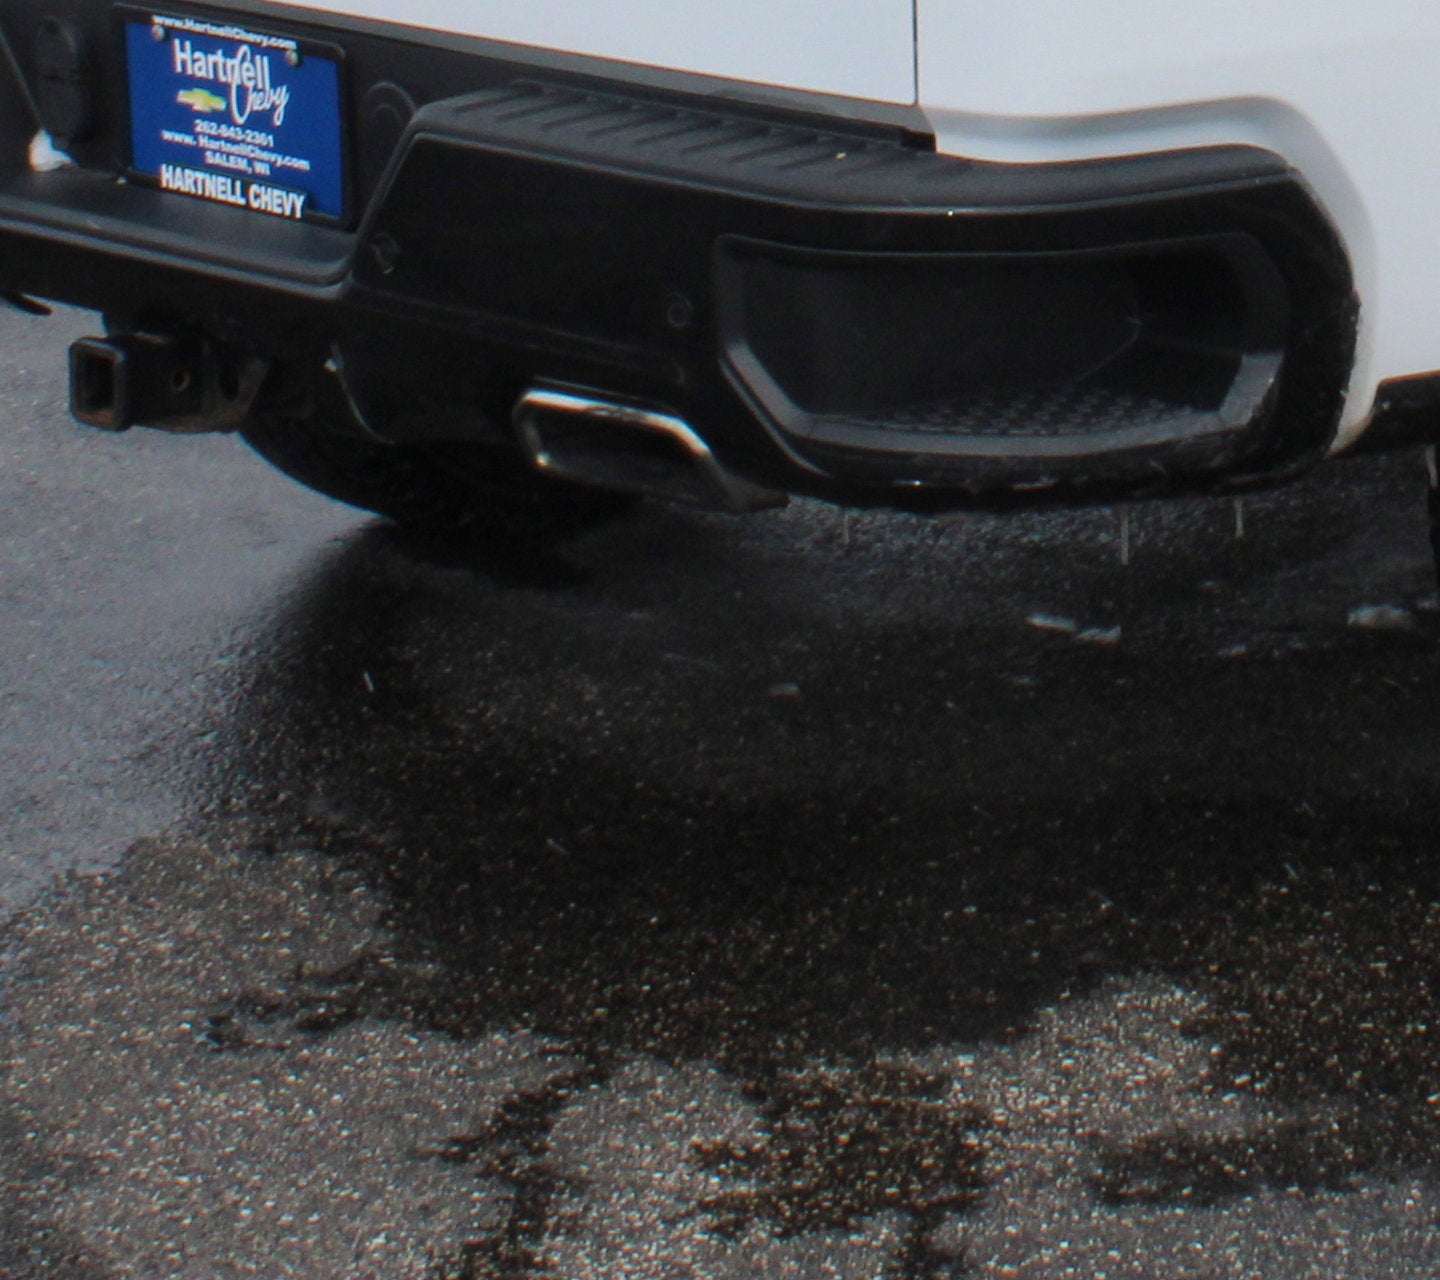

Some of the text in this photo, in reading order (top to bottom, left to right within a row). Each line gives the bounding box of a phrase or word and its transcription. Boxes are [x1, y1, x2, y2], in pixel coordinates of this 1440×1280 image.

[152, 14, 298, 50] www.HartnellChevy.com
[173, 38, 270, 91] Hartnell
[230, 44, 290, 127] Chevy
[204, 151, 271, 177] SALEM, WI
[161, 163, 306, 219] HARTNELL CHEVY
